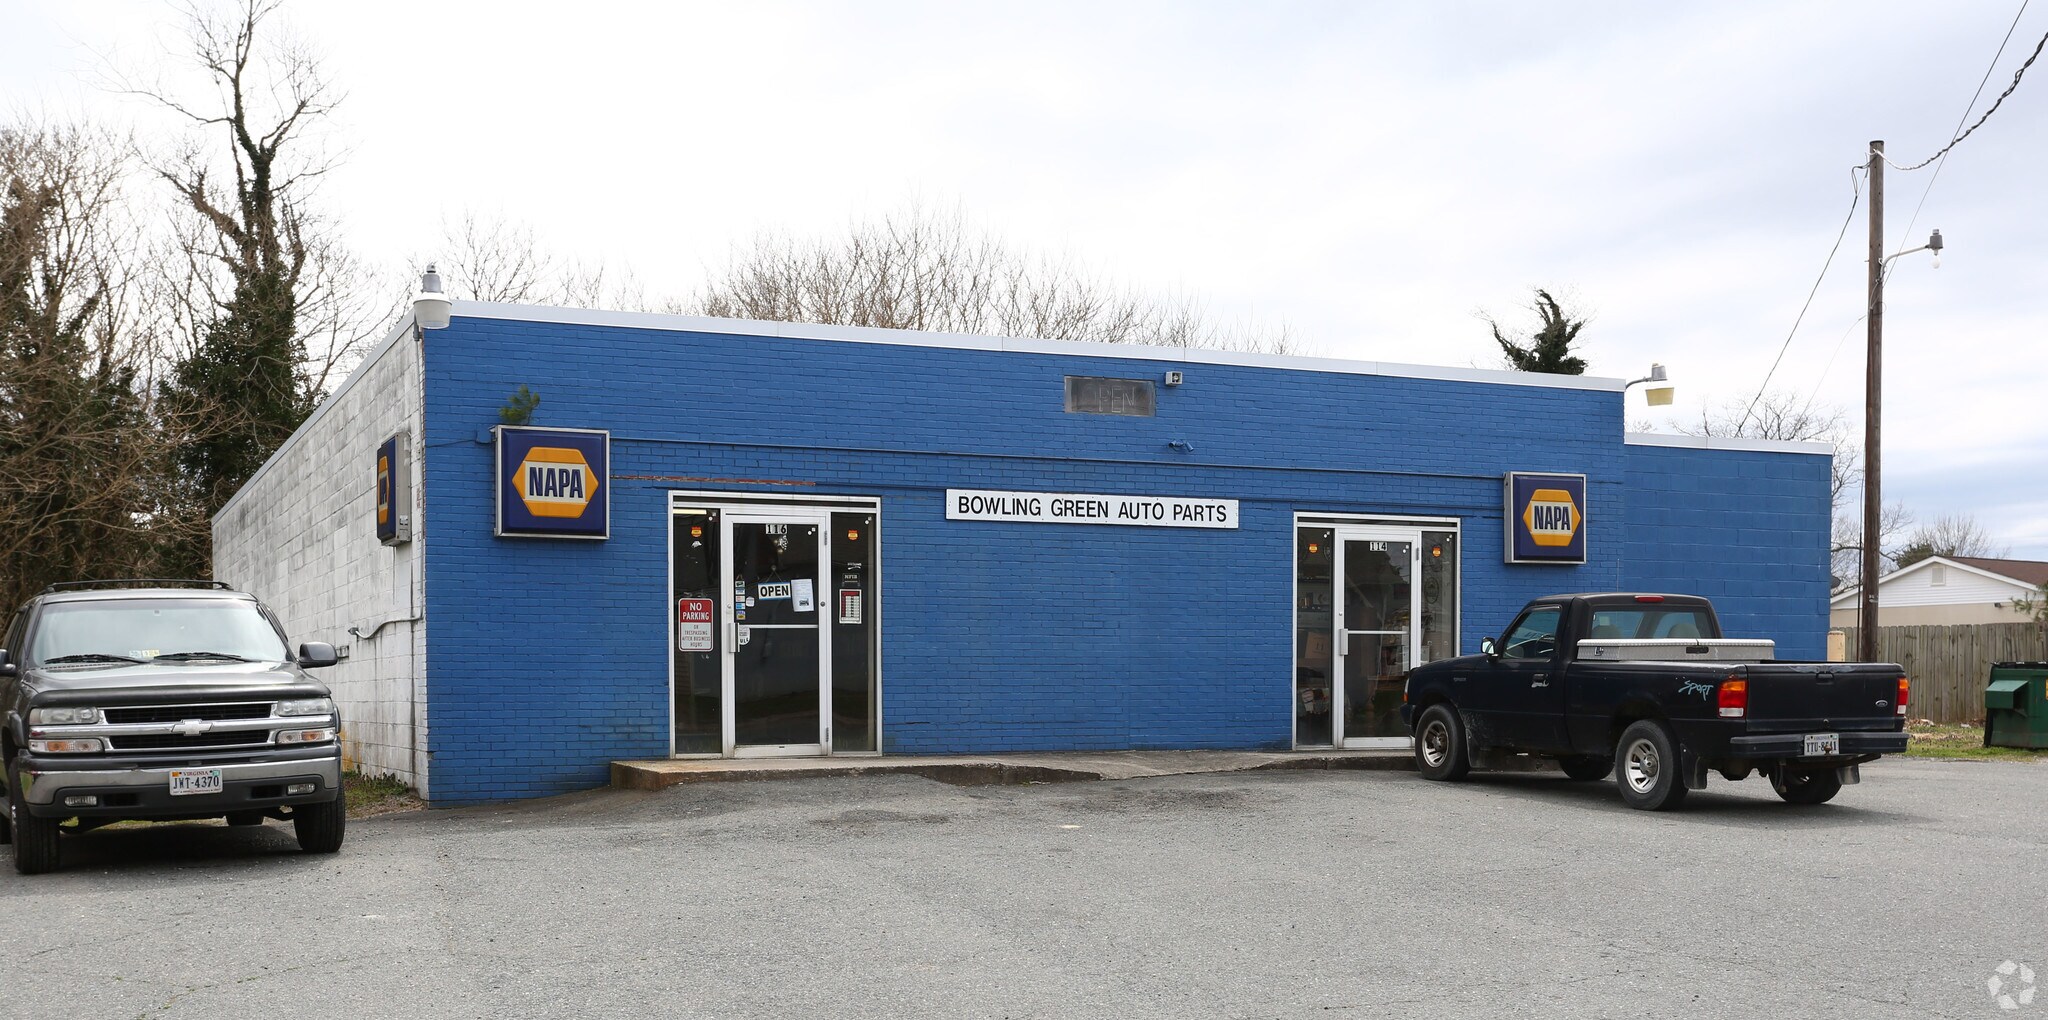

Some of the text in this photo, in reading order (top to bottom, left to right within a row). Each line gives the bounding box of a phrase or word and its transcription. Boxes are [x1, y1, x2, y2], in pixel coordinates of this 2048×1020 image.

[529, 466, 584, 499] NAPA
[958, 495, 1227, 523] BOWLING GREEN AUTO PARTS
[1534, 505, 1571, 531] NAPA
[767, 524, 787, 534] 116
[1371, 542, 1387, 551] 114
[760, 585, 789, 597] OPEN
[689, 602, 702, 611] NO
[682, 611, 709, 621] PARKING
[173, 776, 219, 789] JWT-4370
